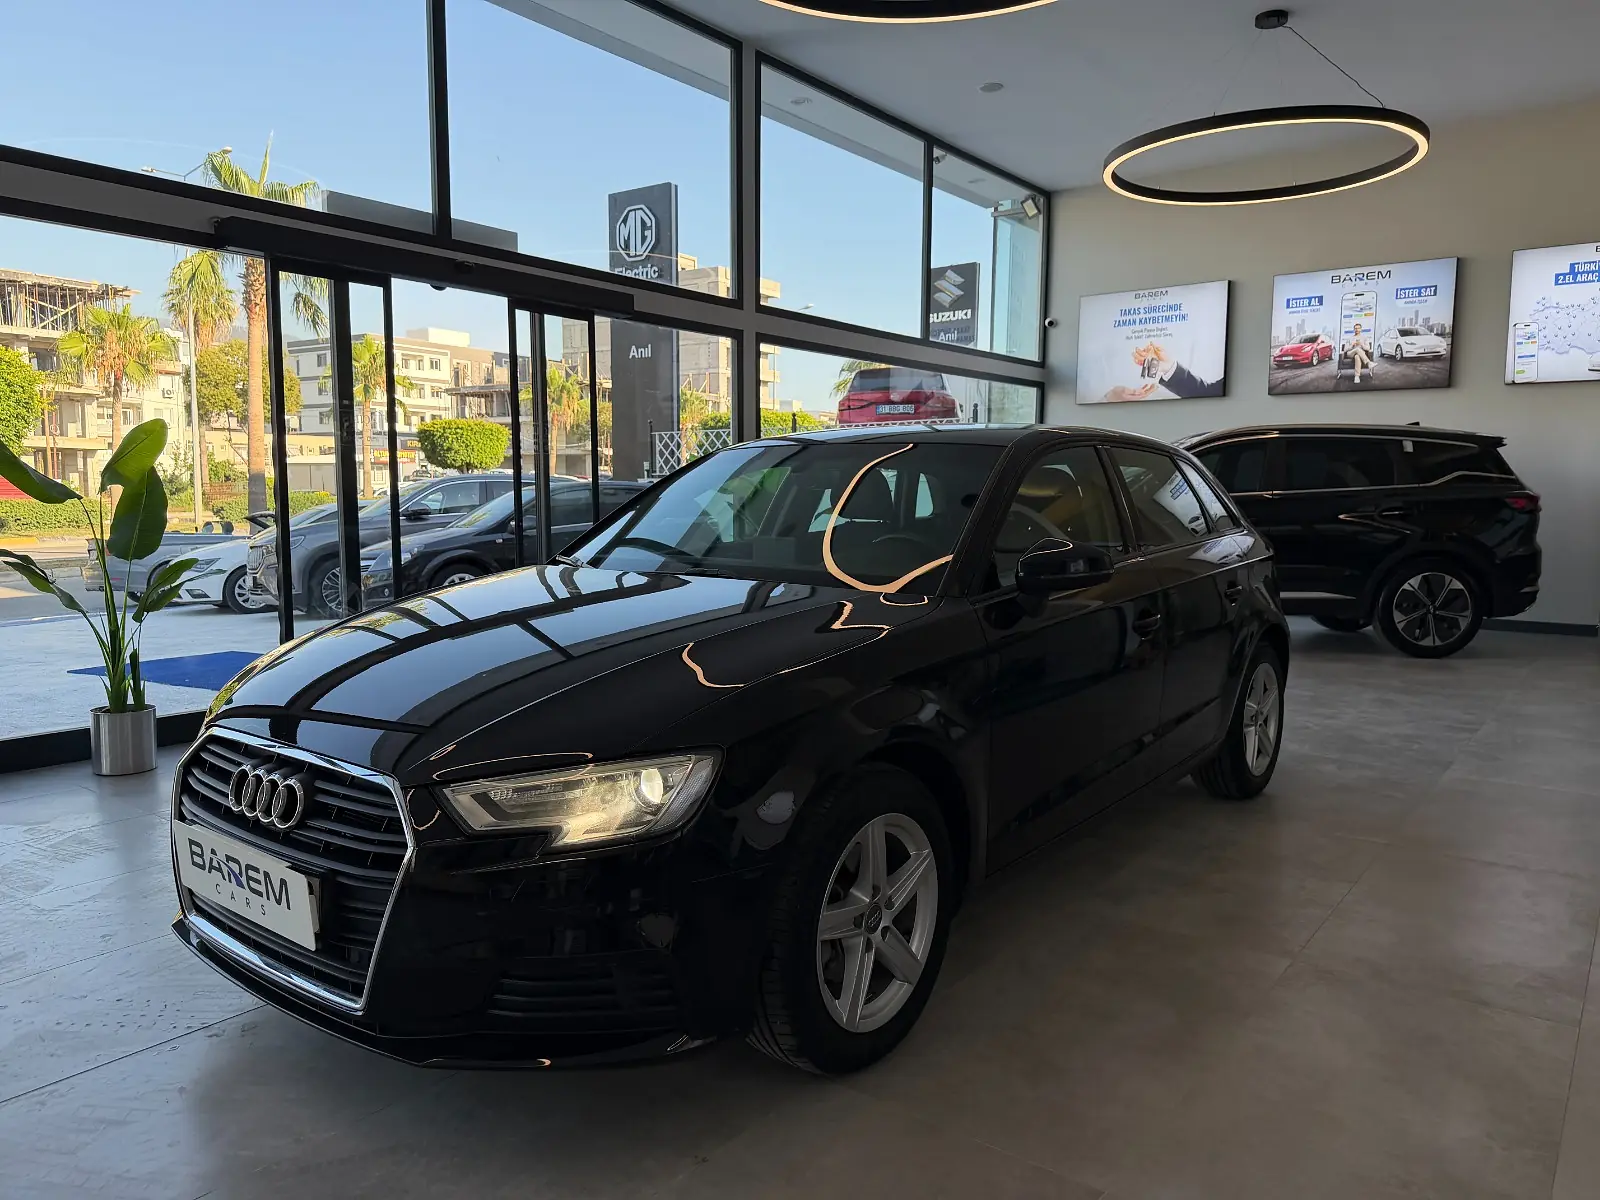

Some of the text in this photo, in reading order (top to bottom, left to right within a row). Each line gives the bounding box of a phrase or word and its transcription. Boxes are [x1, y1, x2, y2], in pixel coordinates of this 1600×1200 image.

[619, 209, 652, 256] MG
[1575, 260, 1600, 272] TÜRKİ
[1331, 270, 1392, 284] BAREM
[1558, 272, 1599, 284] 2.EL ARAÇ
[1134, 290, 1168, 299] BAREM
[1397, 287, 1436, 299] İSTER SAT
[1120, 302, 1183, 317] TAKAS SÜRECİNDE
[1289, 297, 1320, 308] İSTER AL
[930, 308, 972, 323] SUZUKI
[1113, 312, 1189, 328] ZAMAN KAYBETMEYİN!
[629, 344, 652, 359] Anıl
[188, 837, 292, 911] BAREM
[215, 883, 266, 916] CARS
